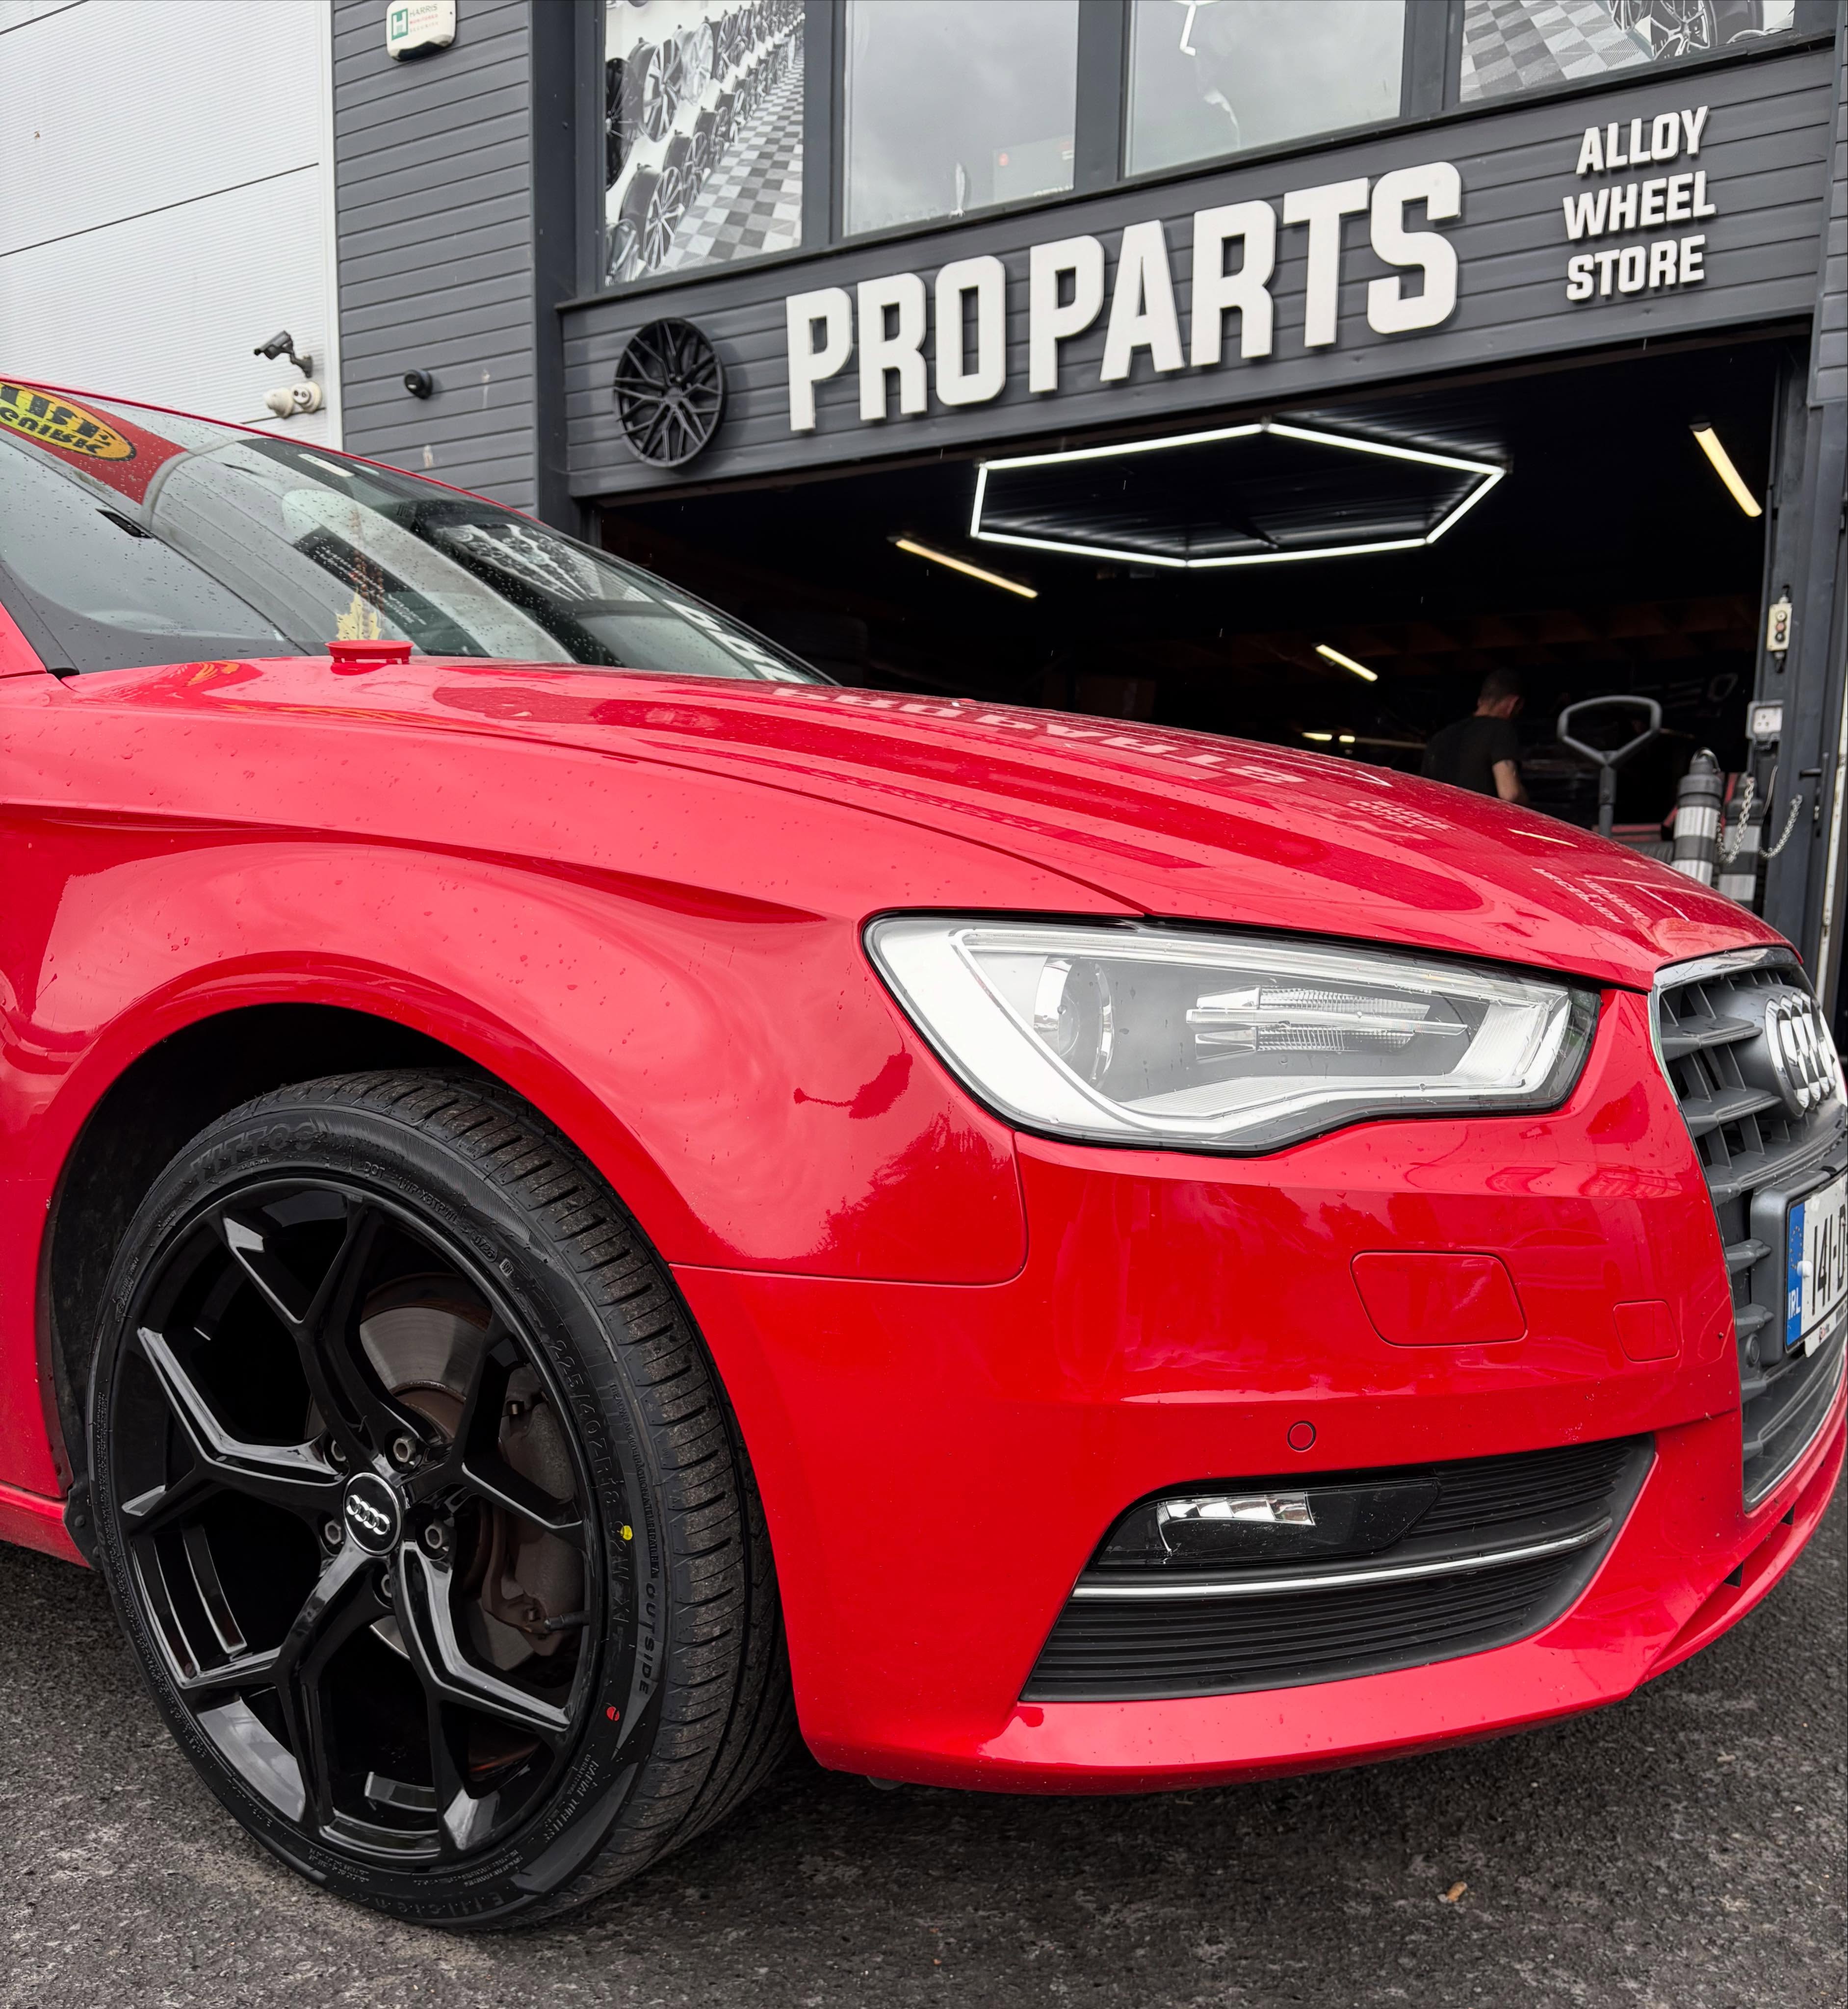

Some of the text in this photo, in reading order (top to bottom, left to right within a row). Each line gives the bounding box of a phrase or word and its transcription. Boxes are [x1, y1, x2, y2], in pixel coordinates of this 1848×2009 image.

[1576, 105, 1709, 176] ALLOY
[1562, 170, 1717, 241] WHEEL
[785, 161, 1462, 432] PRO PARTS
[1566, 234, 1706, 302] STORE
[1788, 1287, 1800, 1320] IRL
[639, 1582, 656, 1695] OUTSIDE
